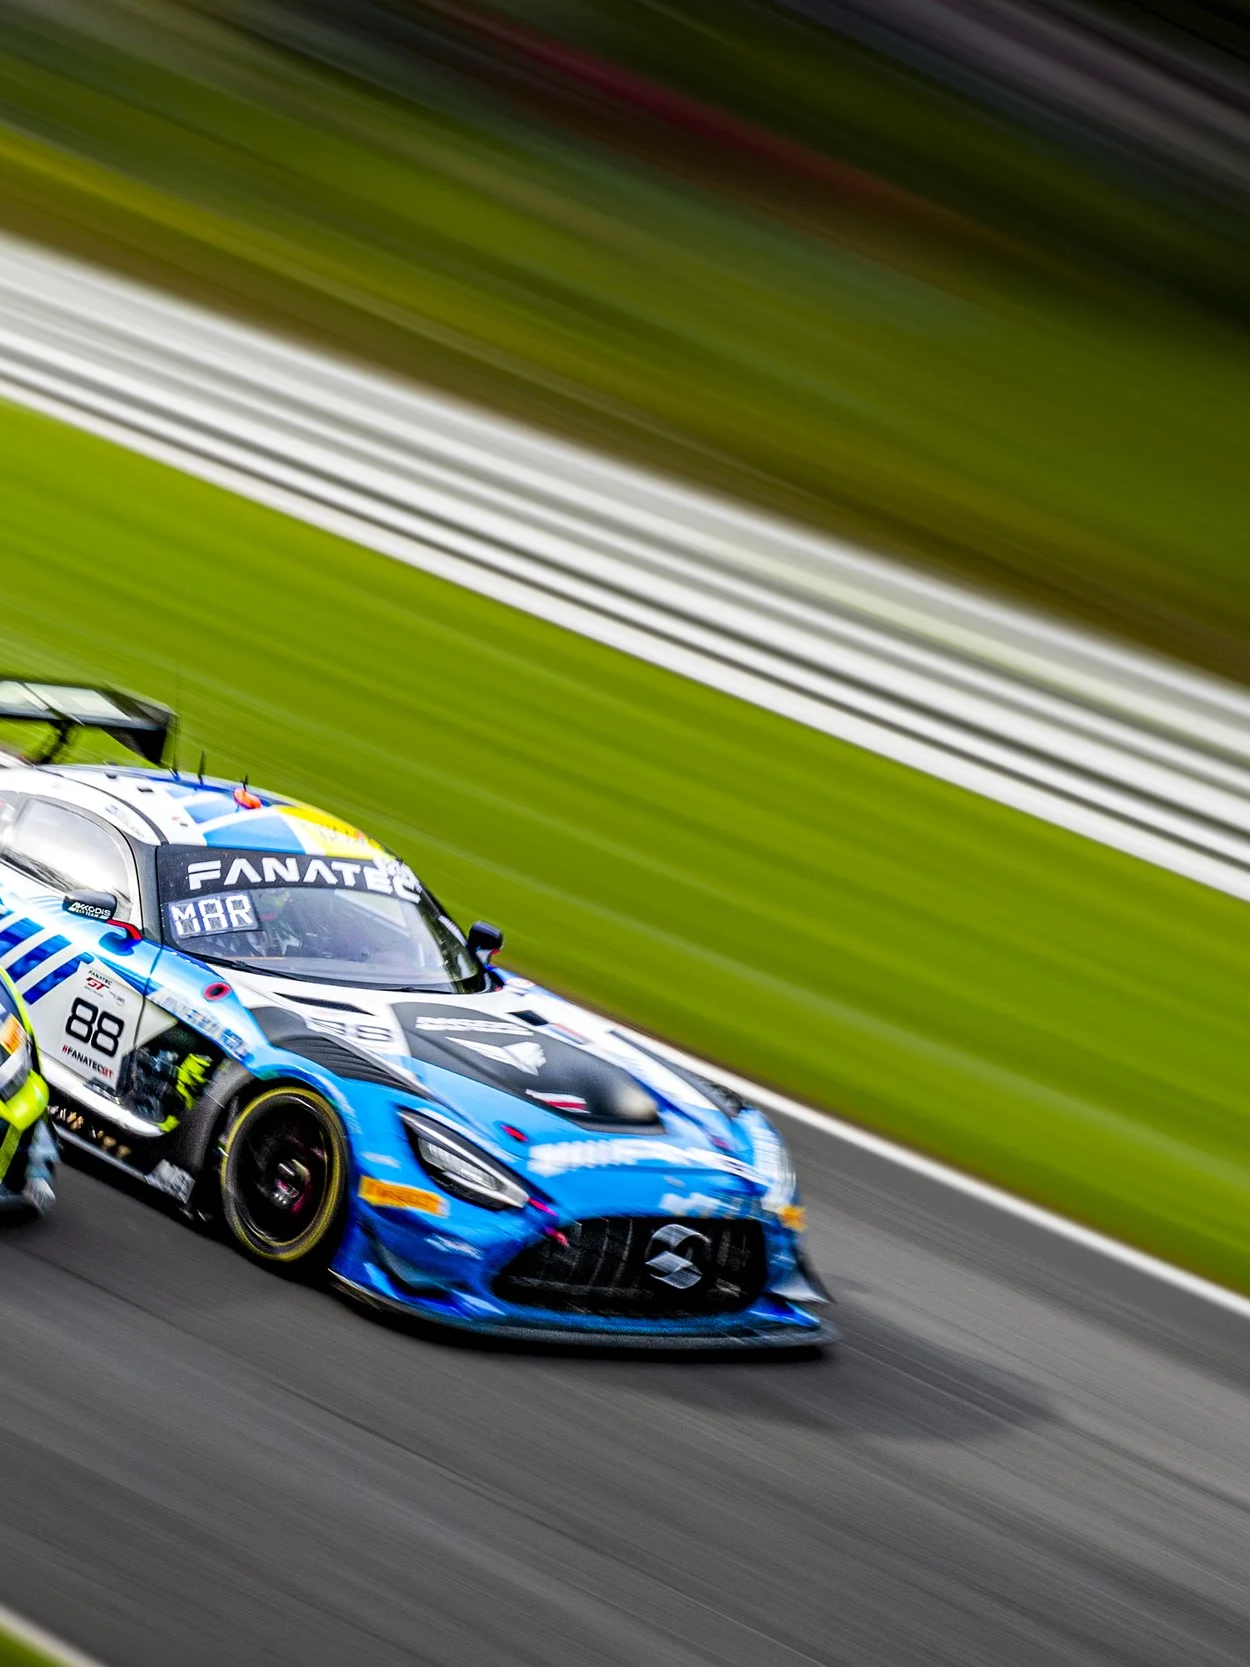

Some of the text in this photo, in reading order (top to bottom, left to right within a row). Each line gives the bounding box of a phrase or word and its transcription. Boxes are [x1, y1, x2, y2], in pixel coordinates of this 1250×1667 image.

[187, 856, 422, 904] FANATEC
[170, 894, 255, 937] MAR
[88, 970, 113, 986] FANATEC
[65, 997, 125, 1058] 88
